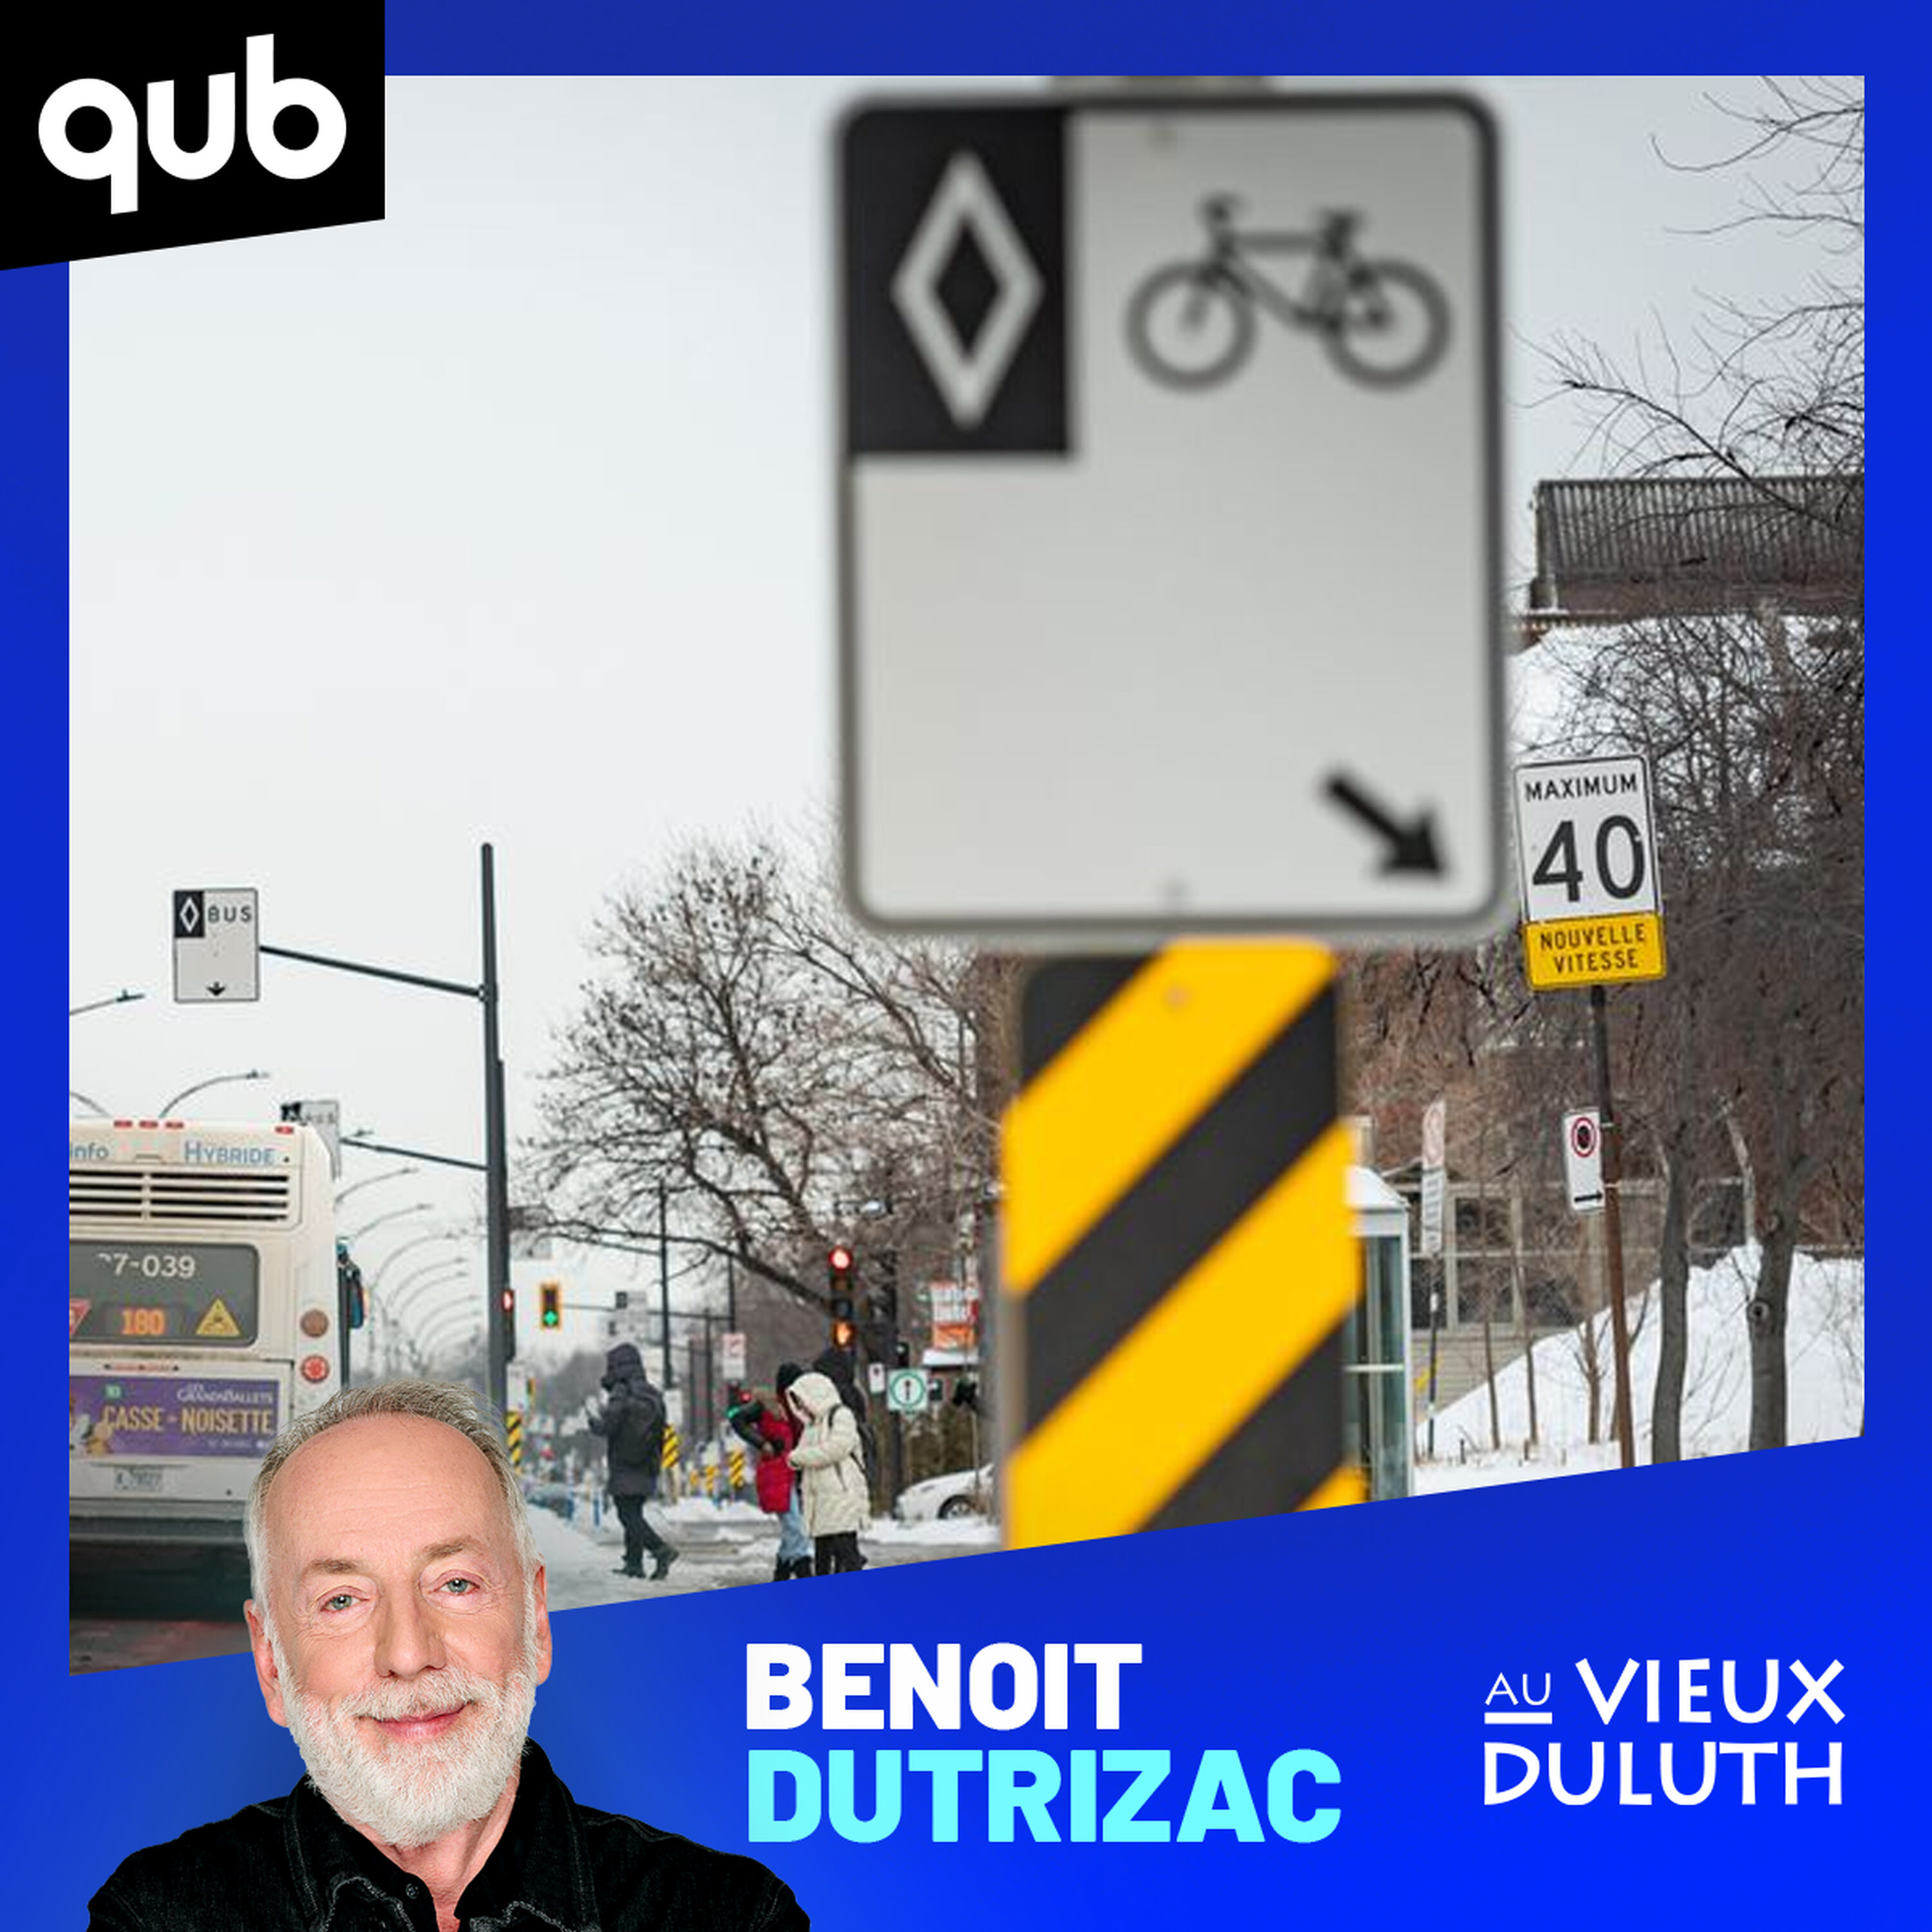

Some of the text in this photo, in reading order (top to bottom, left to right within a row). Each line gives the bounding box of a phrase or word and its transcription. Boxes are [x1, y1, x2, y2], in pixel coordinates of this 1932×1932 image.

[1525, 773, 1637, 802] MAXIMUM
[1533, 814, 1645, 902] 40
[207, 905, 252, 922] BUS
[1540, 923, 1645, 950] NOUVELLE
[1554, 949, 1638, 974] VITESSE
